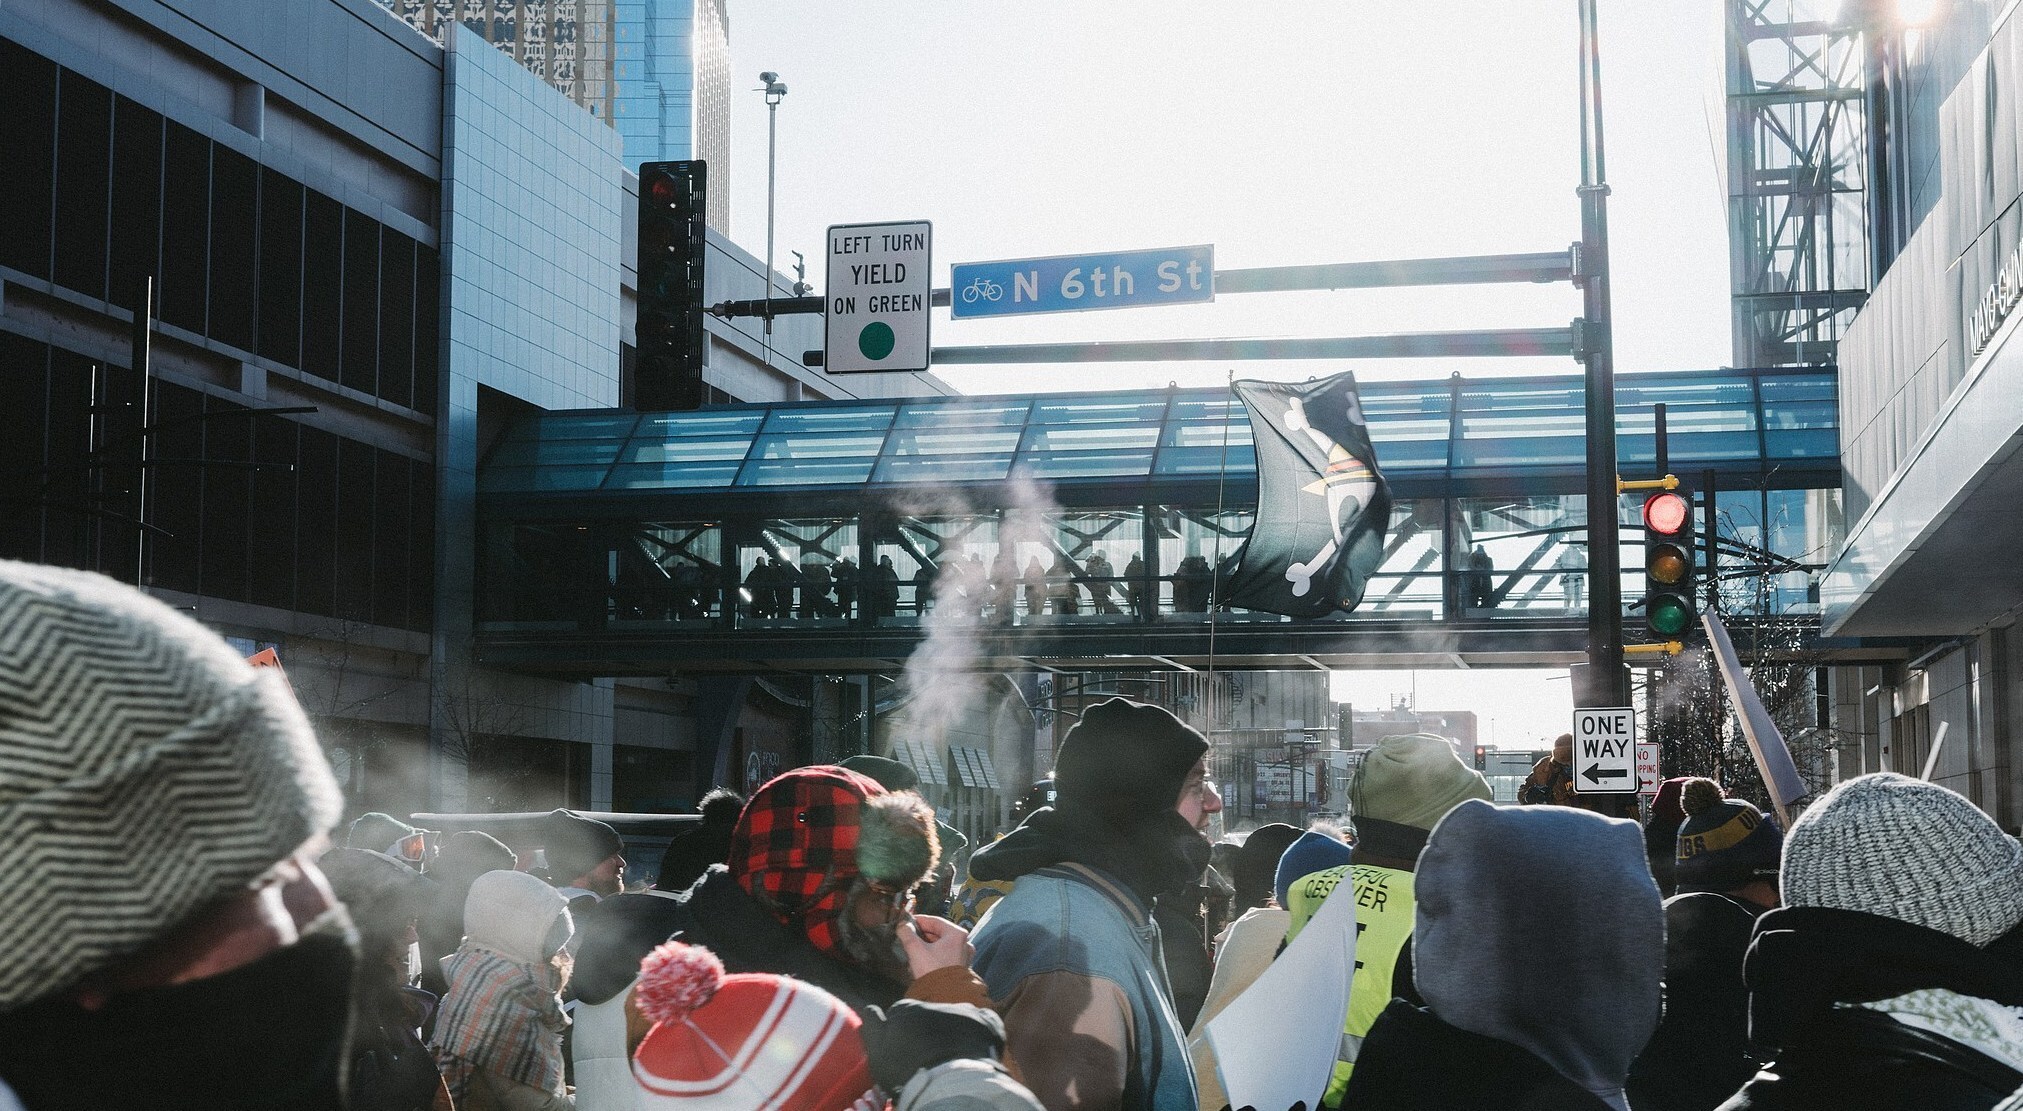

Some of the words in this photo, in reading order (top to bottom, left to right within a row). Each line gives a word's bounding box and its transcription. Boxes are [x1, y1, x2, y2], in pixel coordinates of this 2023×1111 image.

[833, 235, 872, 254] LEFT
[882, 233, 924, 252] TURN
[851, 263, 906, 285] YIELD
[1014, 270, 1038, 302] N
[1061, 265, 1134, 299] 6th
[1157, 259, 1202, 292] St
[834, 297, 856, 314] ON
[869, 294, 922, 313] GREEN
[1969, 283, 1996, 356] MAYO
[1581, 715, 1627, 735] ONE
[1583, 738, 1629, 758] WAY
[1637, 764, 1656, 773] PPING
